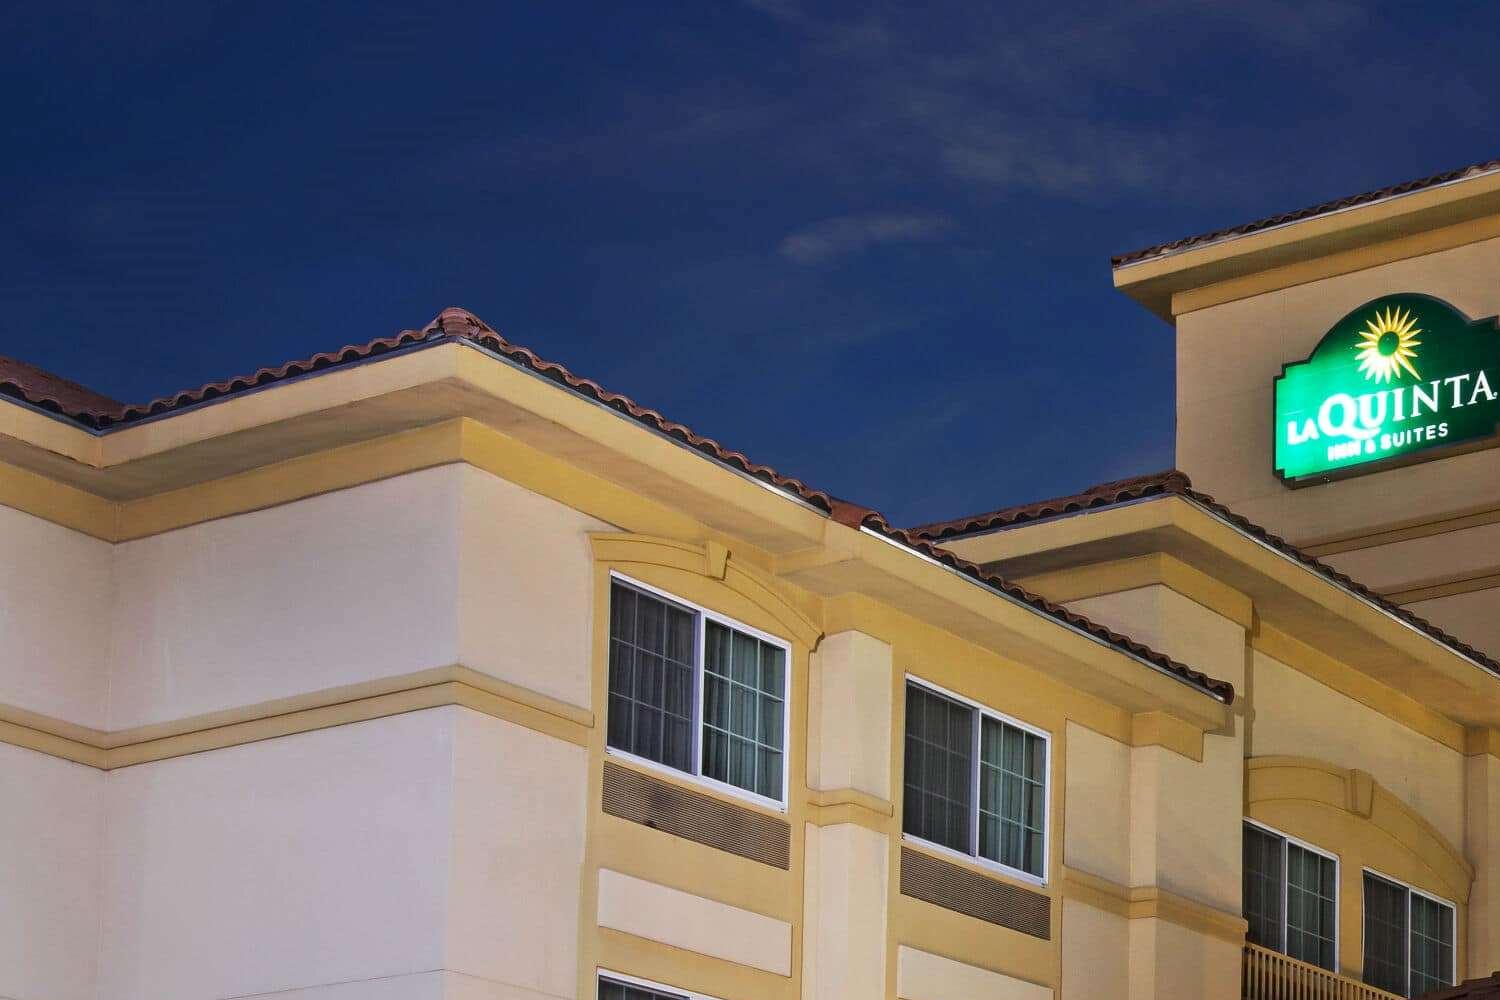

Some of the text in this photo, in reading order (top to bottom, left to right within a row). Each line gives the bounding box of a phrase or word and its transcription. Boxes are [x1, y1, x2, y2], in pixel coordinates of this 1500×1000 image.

[1287, 370, 1495, 445] LA QUINTA
[1380, 422, 1449, 450] SUITES
